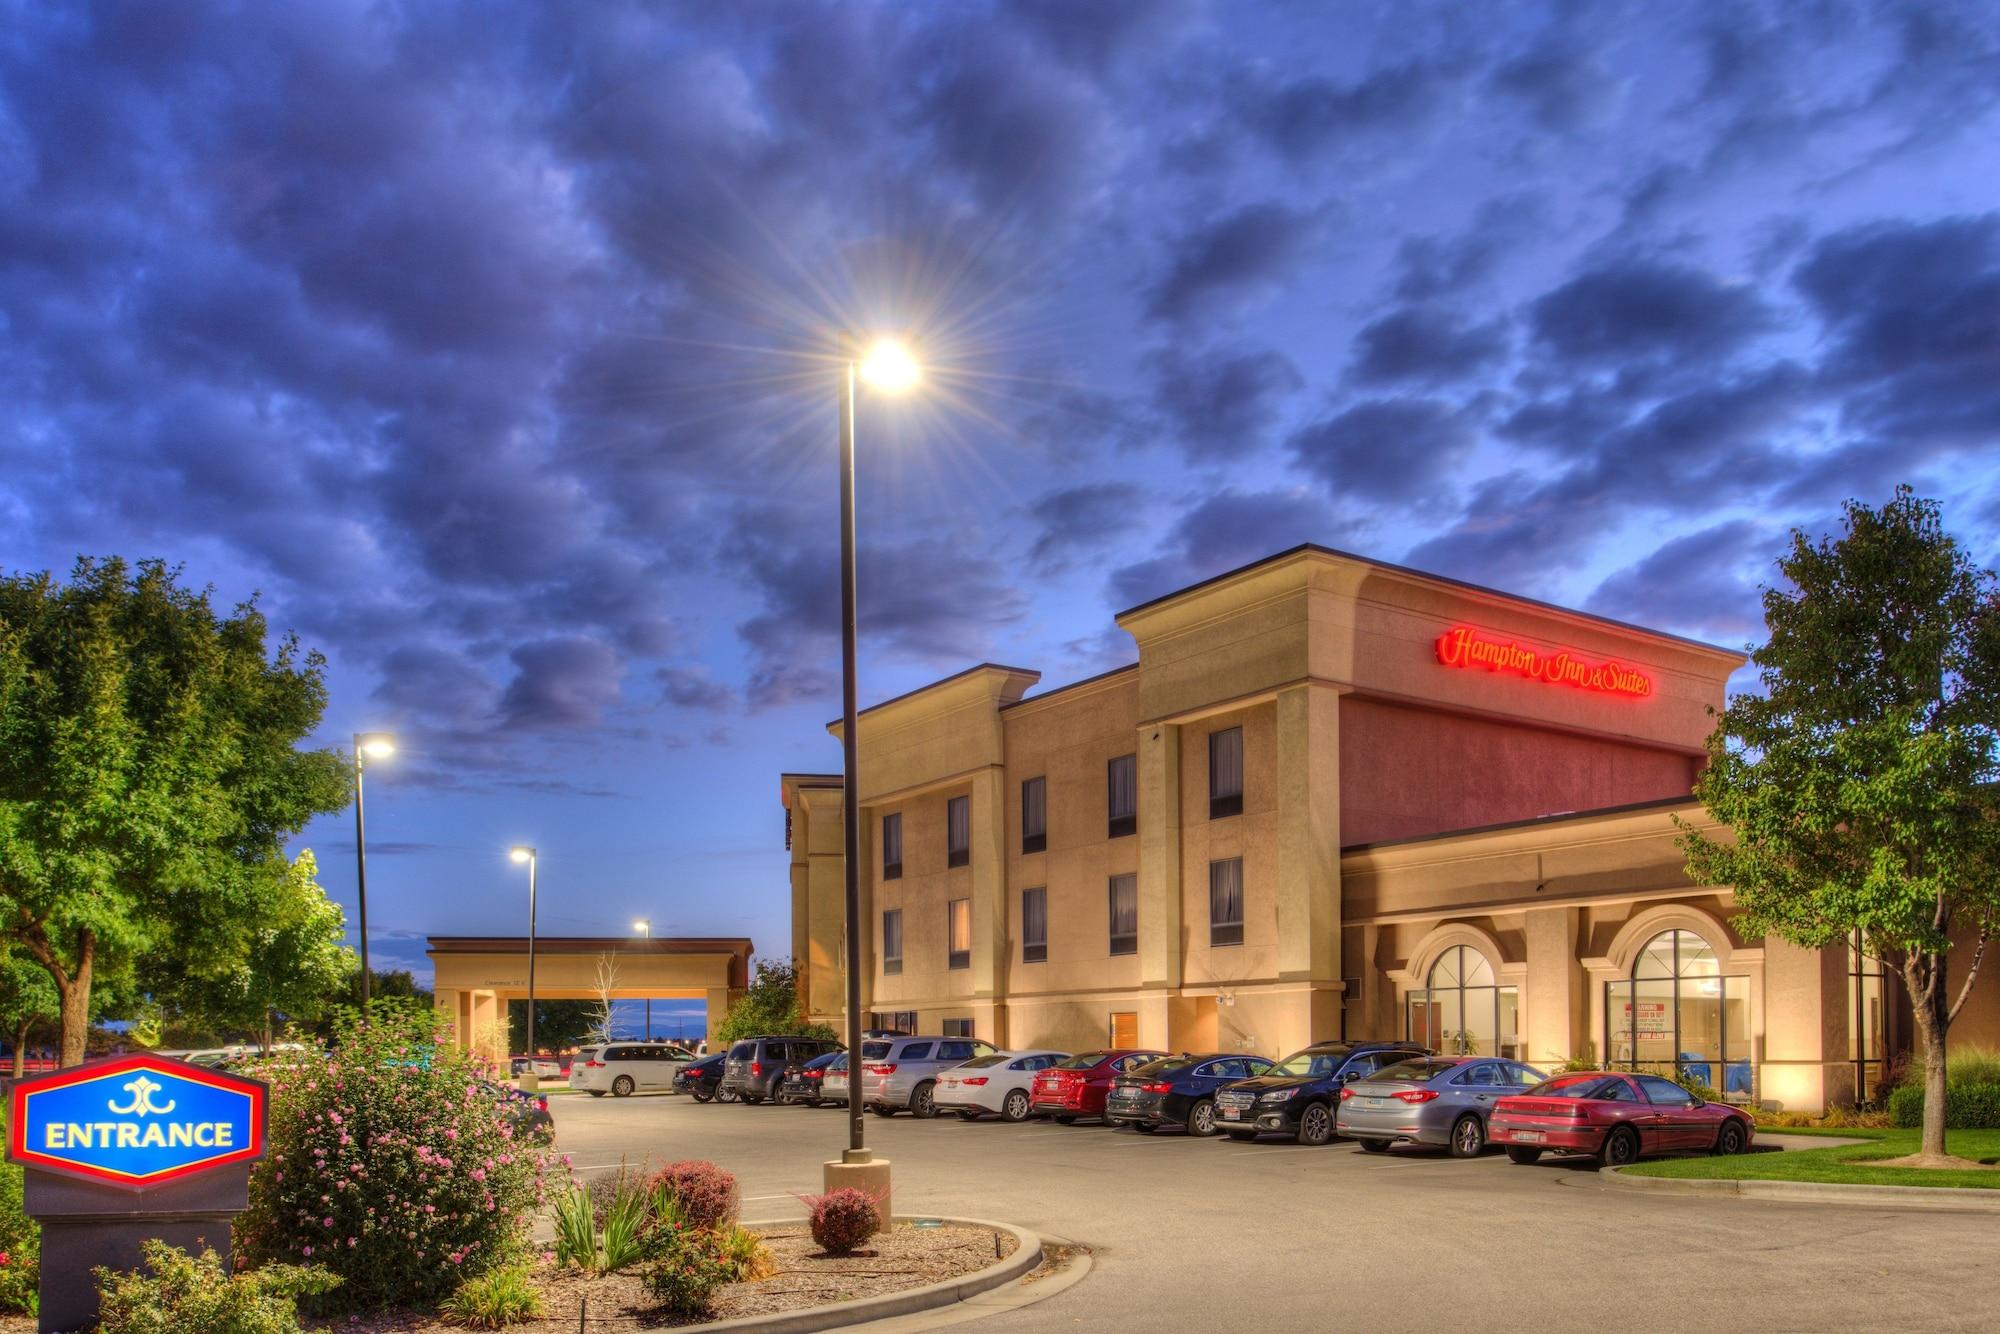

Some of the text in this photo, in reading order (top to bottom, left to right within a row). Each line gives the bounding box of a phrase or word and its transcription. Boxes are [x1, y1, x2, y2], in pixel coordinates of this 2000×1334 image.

[1441, 628, 1543, 677] Hampton
[1546, 653, 1594, 686] Inn
[1601, 662, 1650, 696] Suites
[45, 1122, 233, 1149] ENTRANCE
